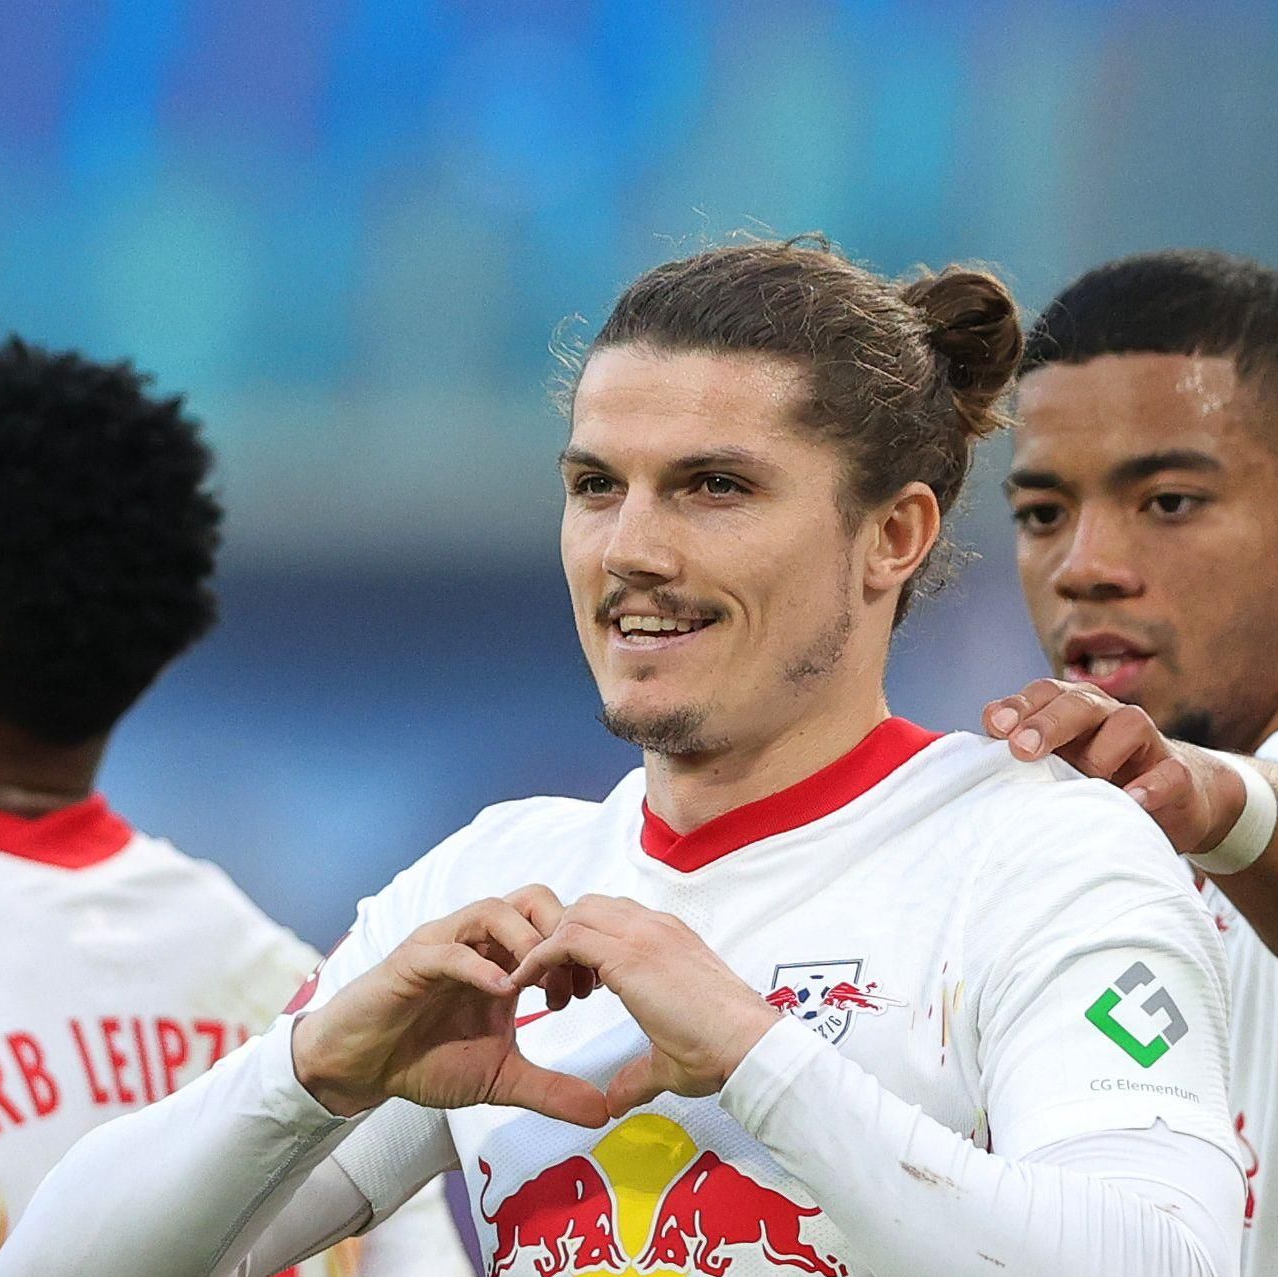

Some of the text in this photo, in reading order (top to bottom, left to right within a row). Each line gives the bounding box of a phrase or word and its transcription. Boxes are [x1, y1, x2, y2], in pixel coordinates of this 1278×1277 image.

[69, 1016, 250, 1104] LEIPZ
[1090, 1079, 1200, 1103] CG Elementum
